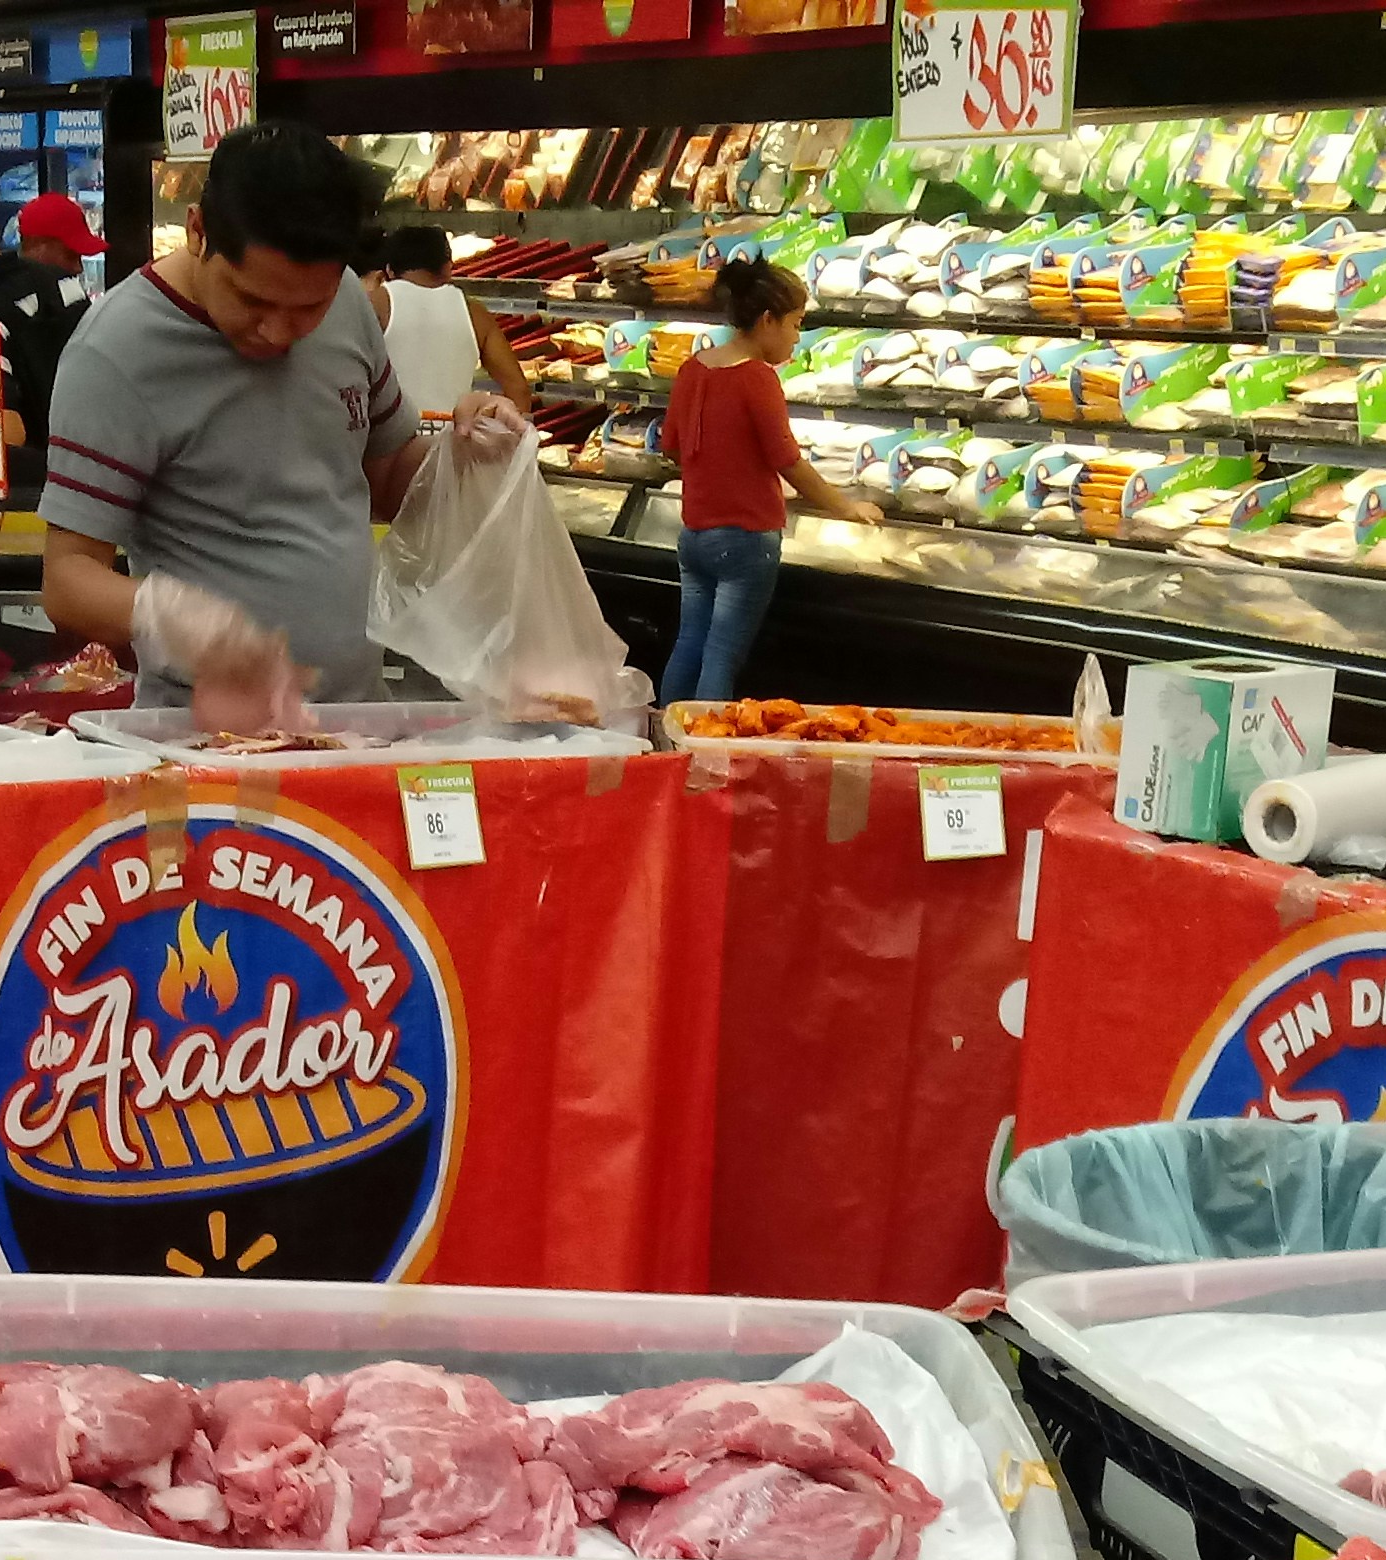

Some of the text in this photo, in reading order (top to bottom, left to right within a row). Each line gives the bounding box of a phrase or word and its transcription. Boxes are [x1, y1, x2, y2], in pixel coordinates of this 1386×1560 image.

[427, 812, 444, 834] 86
[946, 808, 964, 829] 69
[37, 847, 397, 1008] FIN DE SEMANA
[5, 975, 393, 1164] de Asador
[1258, 993, 1332, 1075] FIN
